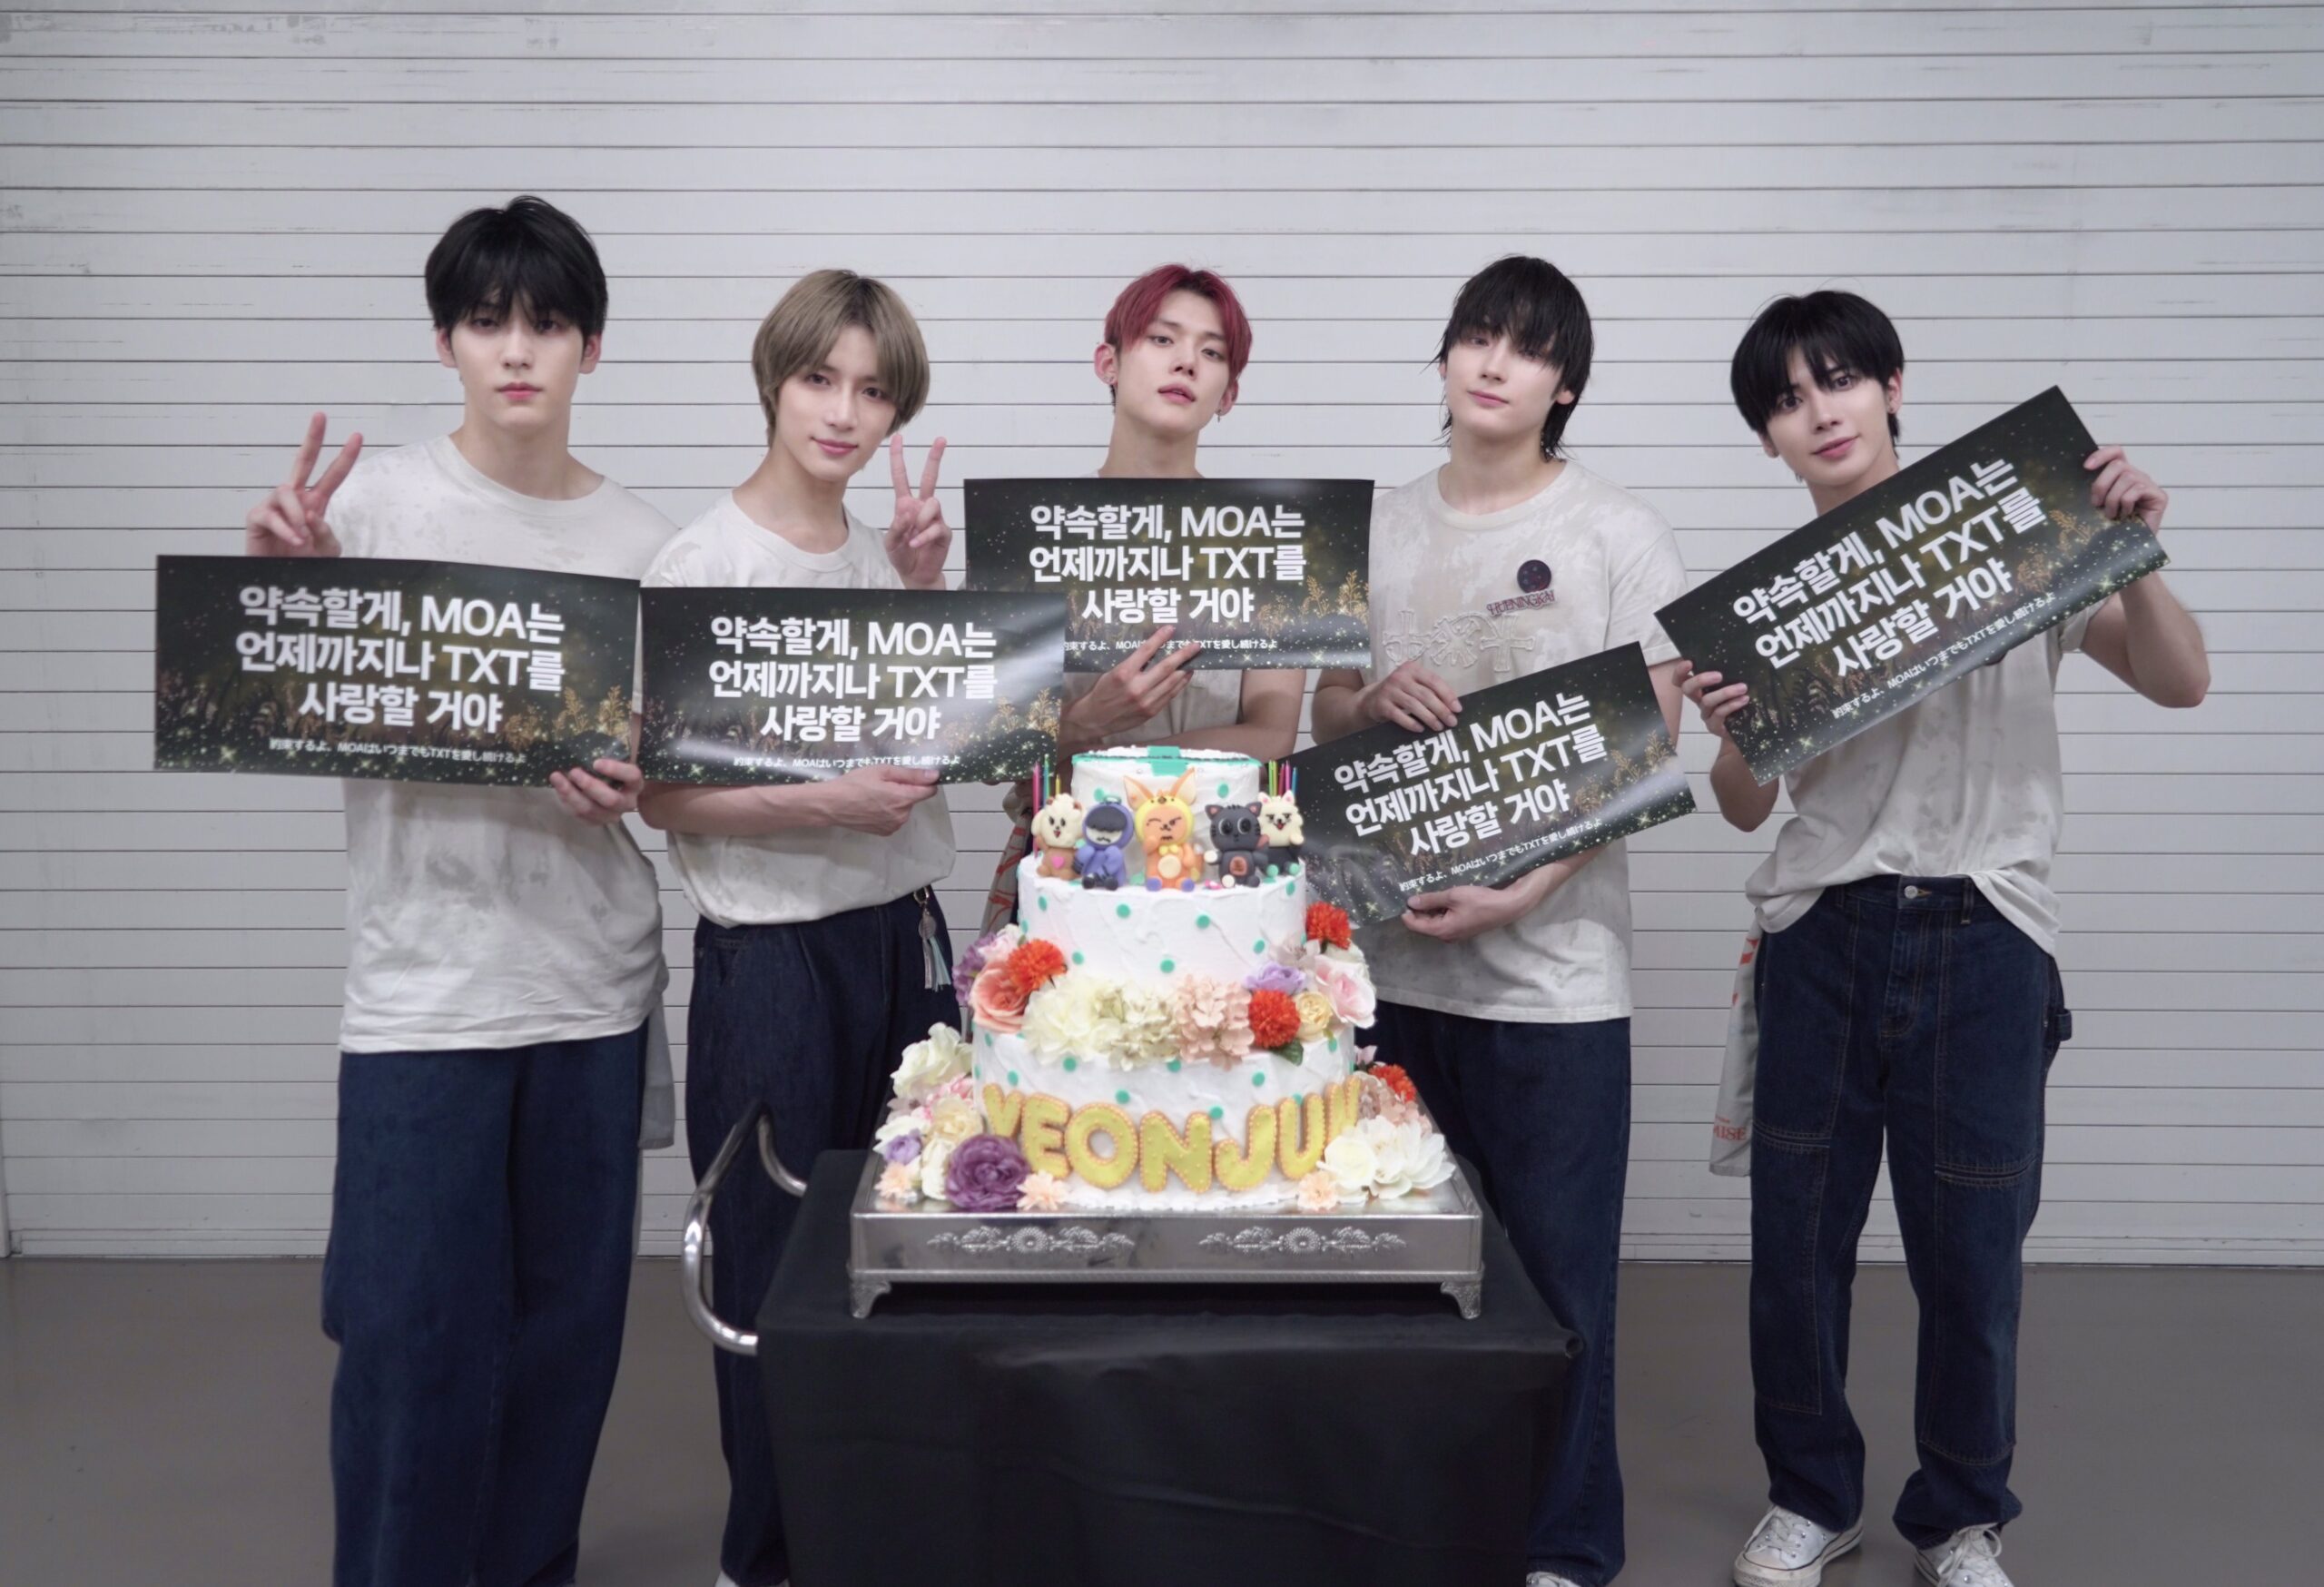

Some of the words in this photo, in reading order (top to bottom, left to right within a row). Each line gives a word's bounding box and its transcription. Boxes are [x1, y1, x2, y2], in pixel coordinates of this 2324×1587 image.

[1030, 504, 1172, 544] 약속할게,
[1181, 505, 1305, 538] MOA는
[1733, 539, 1885, 624] 약속할게,
[1876, 459, 2017, 549] MOA는
[1029, 545, 1195, 583] 언제까지나
[1199, 544, 1307, 581] TXT를
[1755, 558, 1926, 669] 언제까지나
[1920, 493, 2046, 572] TXT를
[241, 587, 411, 636] 약속할게,
[421, 596, 565, 645] MOA는
[1080, 586, 1182, 625] 사랑할
[1188, 586, 1256, 626] 거야
[1832, 602, 1939, 676] 사랑할
[1933, 560, 2014, 619] 거야
[237, 632, 436, 681] 언제까지나
[441, 645, 566, 692] TXT를
[711, 616, 859, 661] 약속할게,
[867, 621, 997, 658] MOA는
[299, 682, 419, 726] 사랑할
[427, 690, 503, 734] 거야
[709, 661, 881, 699] 언제까지나
[887, 664, 997, 700] TXT를
[761, 705, 864, 743] 사랑할
[872, 706, 940, 742] 거야
[1334, 733, 1471, 794] 약속할게,
[1469, 695, 1591, 753] MOA는
[1345, 762, 1500, 837] 언제까지나
[1499, 724, 1608, 783] TXT를
[1410, 803, 1502, 856] 사랑할
[1503, 780, 1571, 824] 거야
[982, 1076, 1361, 1193] YEONJUN
